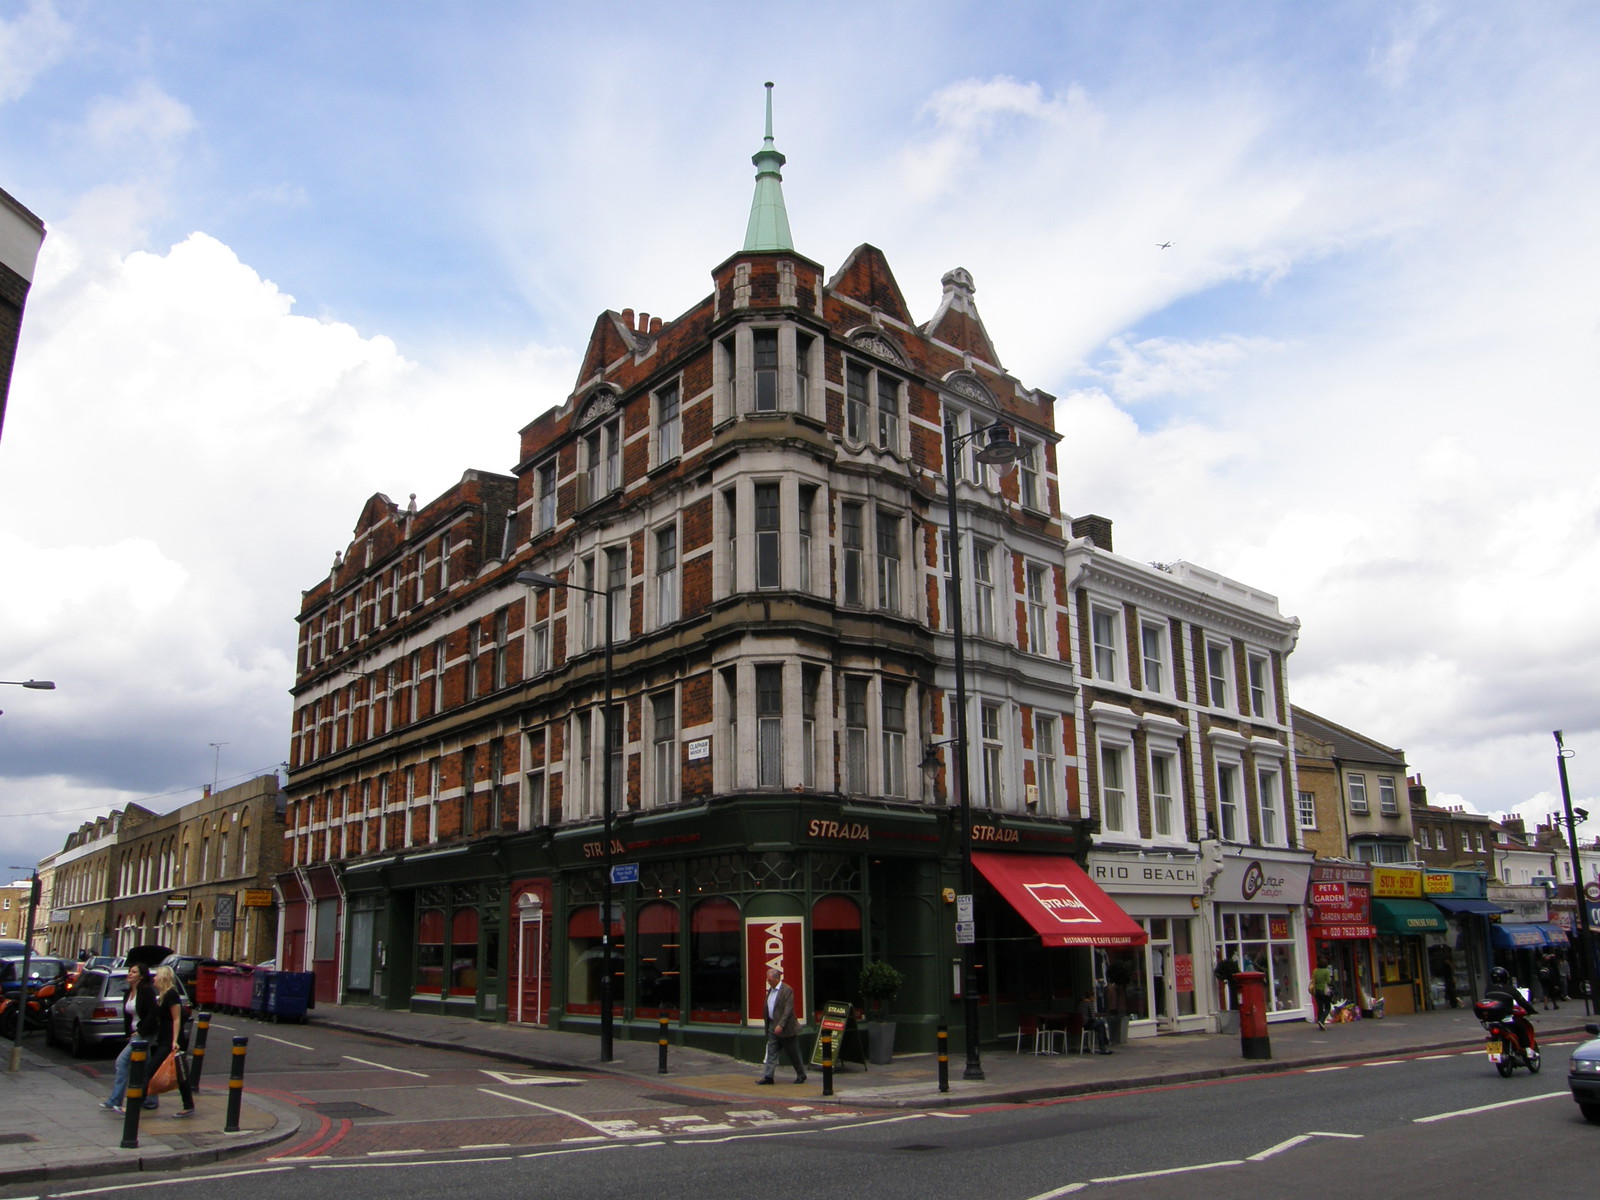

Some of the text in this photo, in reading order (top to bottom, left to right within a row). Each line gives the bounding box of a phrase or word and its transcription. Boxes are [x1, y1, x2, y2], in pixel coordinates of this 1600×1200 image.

[690, 741, 708, 750] CLAPHAM
[809, 820, 870, 840] STRADA
[971, 825, 1019, 842] STRADA
[1096, 866, 1195, 881] RIO BEACH
[1322, 869, 1333, 879] PET
[1343, 870, 1365, 880] GARDEN
[1348, 888, 1367, 898] UATICS
[1040, 899, 1084, 908] STRADA
[1320, 913, 1362, 921] GARDEN SUPPLIES
[1272, 923, 1287, 933] SALE
[1176, 962, 1192, 976] sale
[828, 1006, 846, 1014] STRADA
